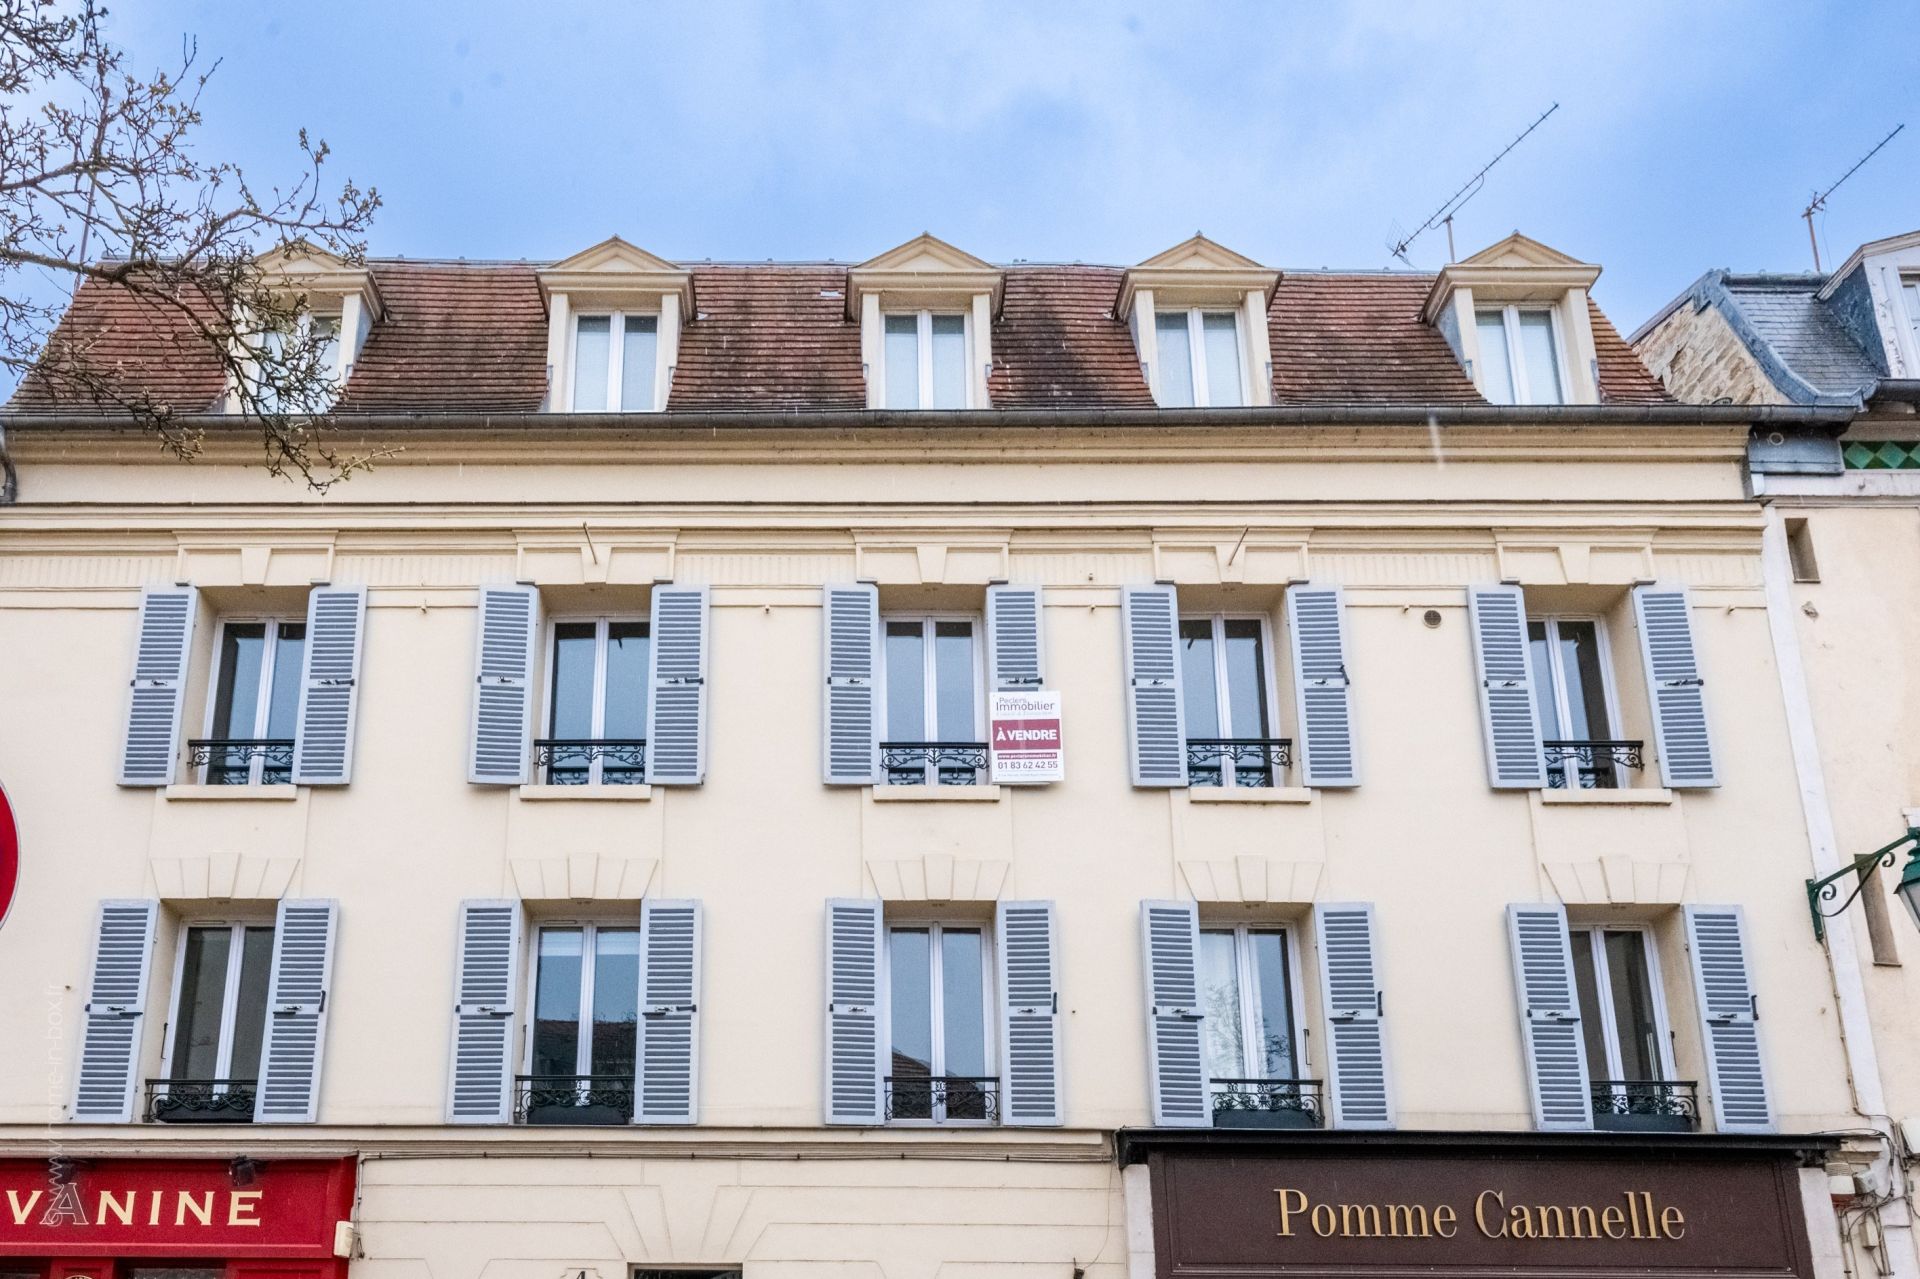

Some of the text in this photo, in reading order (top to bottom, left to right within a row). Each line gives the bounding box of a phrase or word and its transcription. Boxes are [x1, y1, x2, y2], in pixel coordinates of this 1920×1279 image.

[996, 702, 1055, 711] Immobilier
[996, 727, 1058, 741] À VENDRE
[1035, 761, 1046, 769] 42
[1047, 761, 1058, 769] 55
[6, 1183, 262, 1226] VANINE
[1273, 1188, 1686, 1240] Pomme Cannelle
